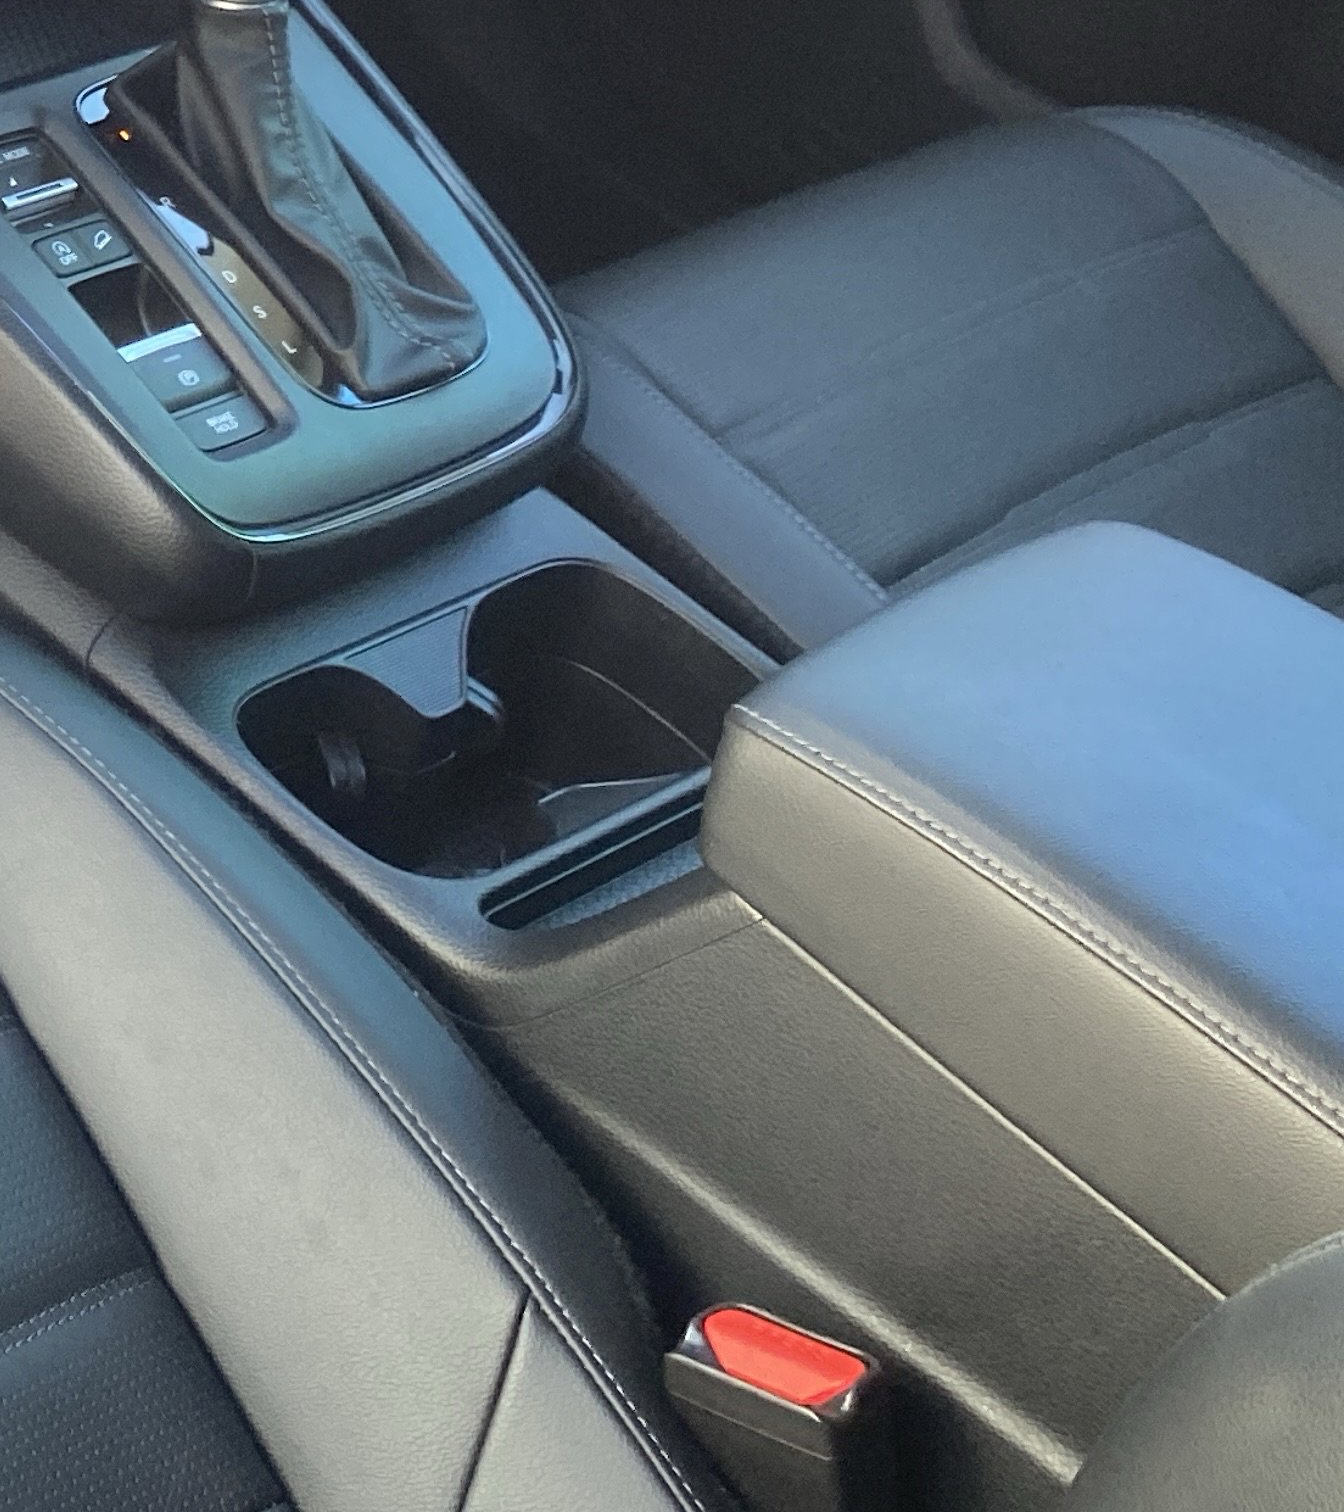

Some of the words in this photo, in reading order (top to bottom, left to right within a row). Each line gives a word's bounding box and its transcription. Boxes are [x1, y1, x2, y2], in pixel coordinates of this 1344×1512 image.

[221, 269, 238, 284] D
[252, 304, 268, 320] S
[280, 340, 298, 355] L
